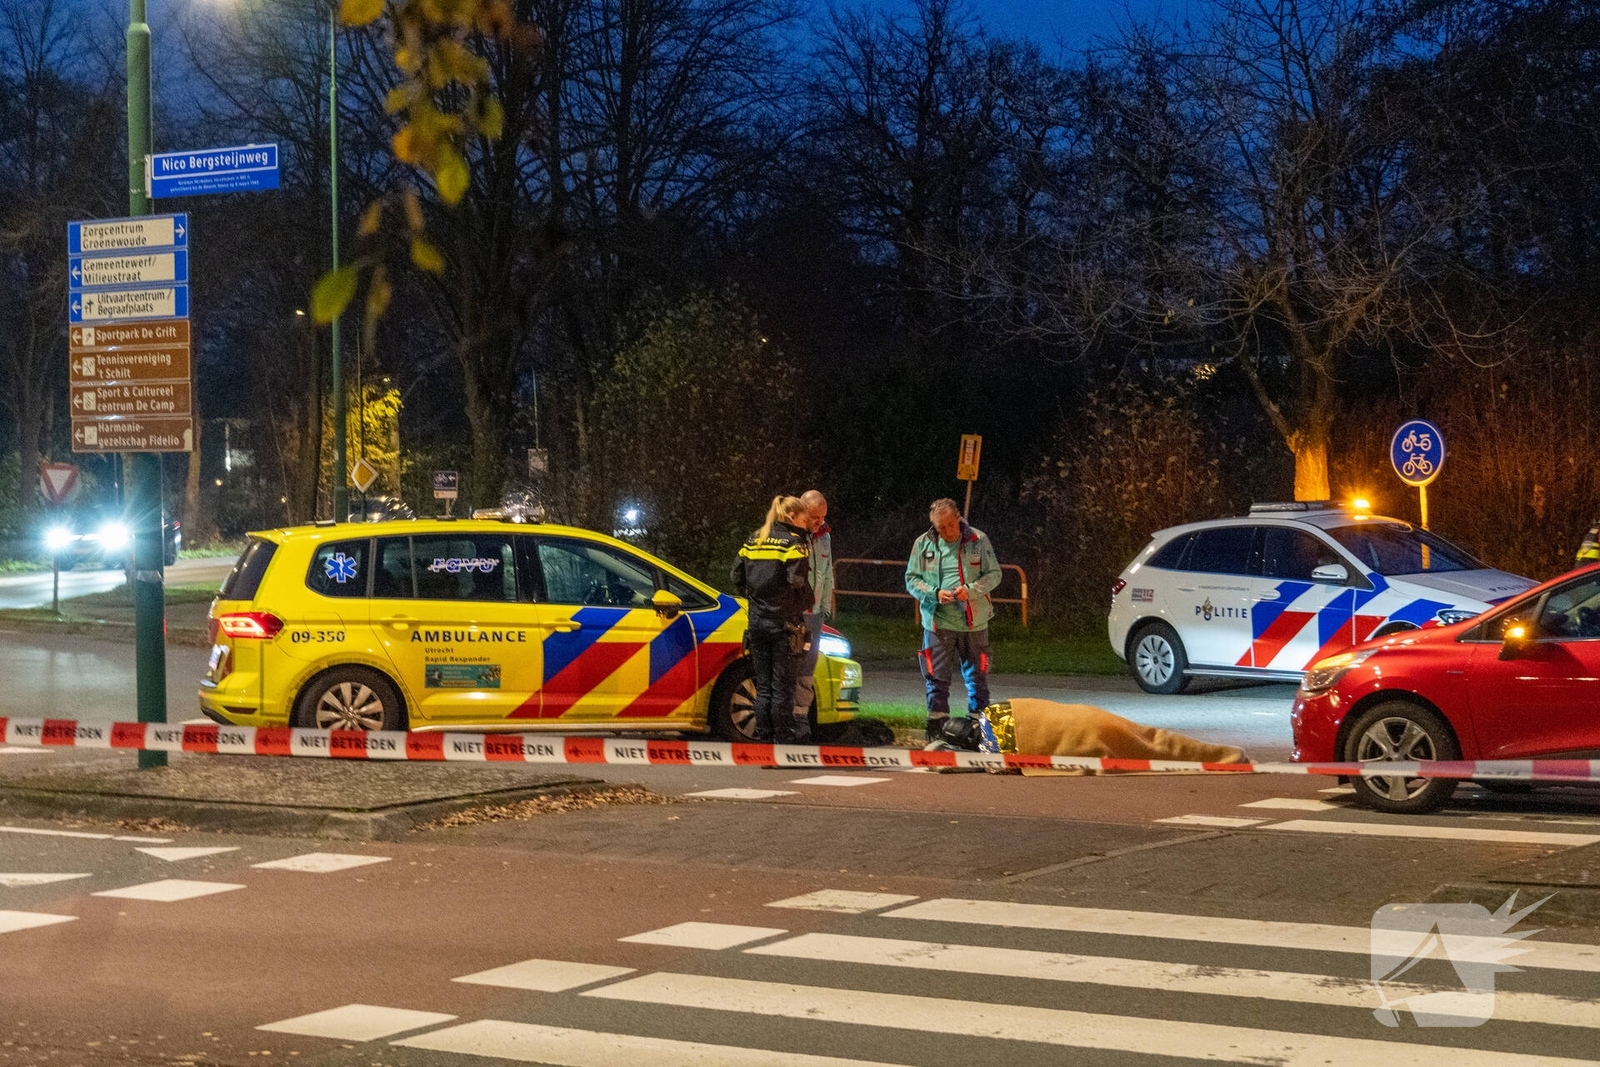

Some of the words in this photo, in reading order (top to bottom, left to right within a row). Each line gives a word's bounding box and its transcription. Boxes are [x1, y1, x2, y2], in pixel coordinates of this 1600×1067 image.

[162, 158, 185, 171] Nico
[189, 152, 268, 170] Bergsteijnweg
[83, 224, 144, 238] Zorgcentrum
[83, 236, 146, 249] Groenewoude
[84, 256, 156, 271] Gemeentewerf/
[84, 272, 140, 284] Milieustraat
[98, 290, 164, 304] Uitvaartcentrum
[98, 303, 154, 316] Begraafplaats
[96, 328, 139, 342] Sportpark
[142, 328, 153, 338] De
[156, 327, 177, 338] Grift
[97, 353, 171, 366] Tennisvereniging
[97, 387, 120, 399] Sport
[123, 387, 129, 397] &
[132, 385, 173, 397] Cultureel
[97, 400, 134, 411] centrum
[136, 400, 148, 410] De
[150, 400, 174, 411] Camp
[98, 422, 144, 433] Harmonie-
[98, 436, 147, 449] gezelschap
[150, 435, 179, 446] Fidelio
[1196, 606, 1247, 620] POLITIE
[292, 631, 345, 643] 09-350
[411, 630, 526, 642] AMBULANCE
[14, 724, 41, 736] NIET
[42, 725, 102, 740] BETREDEN
[154, 730, 181, 742] NIET
[183, 731, 246, 745] BETREDEN
[300, 736, 328, 748] NIET
[332, 738, 396, 750] BETREDEN
[453, 742, 482, 754] NIET
[487, 743, 554, 756] BETREDEN
[615, 747, 644, 759] NIET
[650, 749, 721, 761] BETREDEN
[786, 753, 818, 763] NIET
[823, 754, 900, 766] BETREDEN
